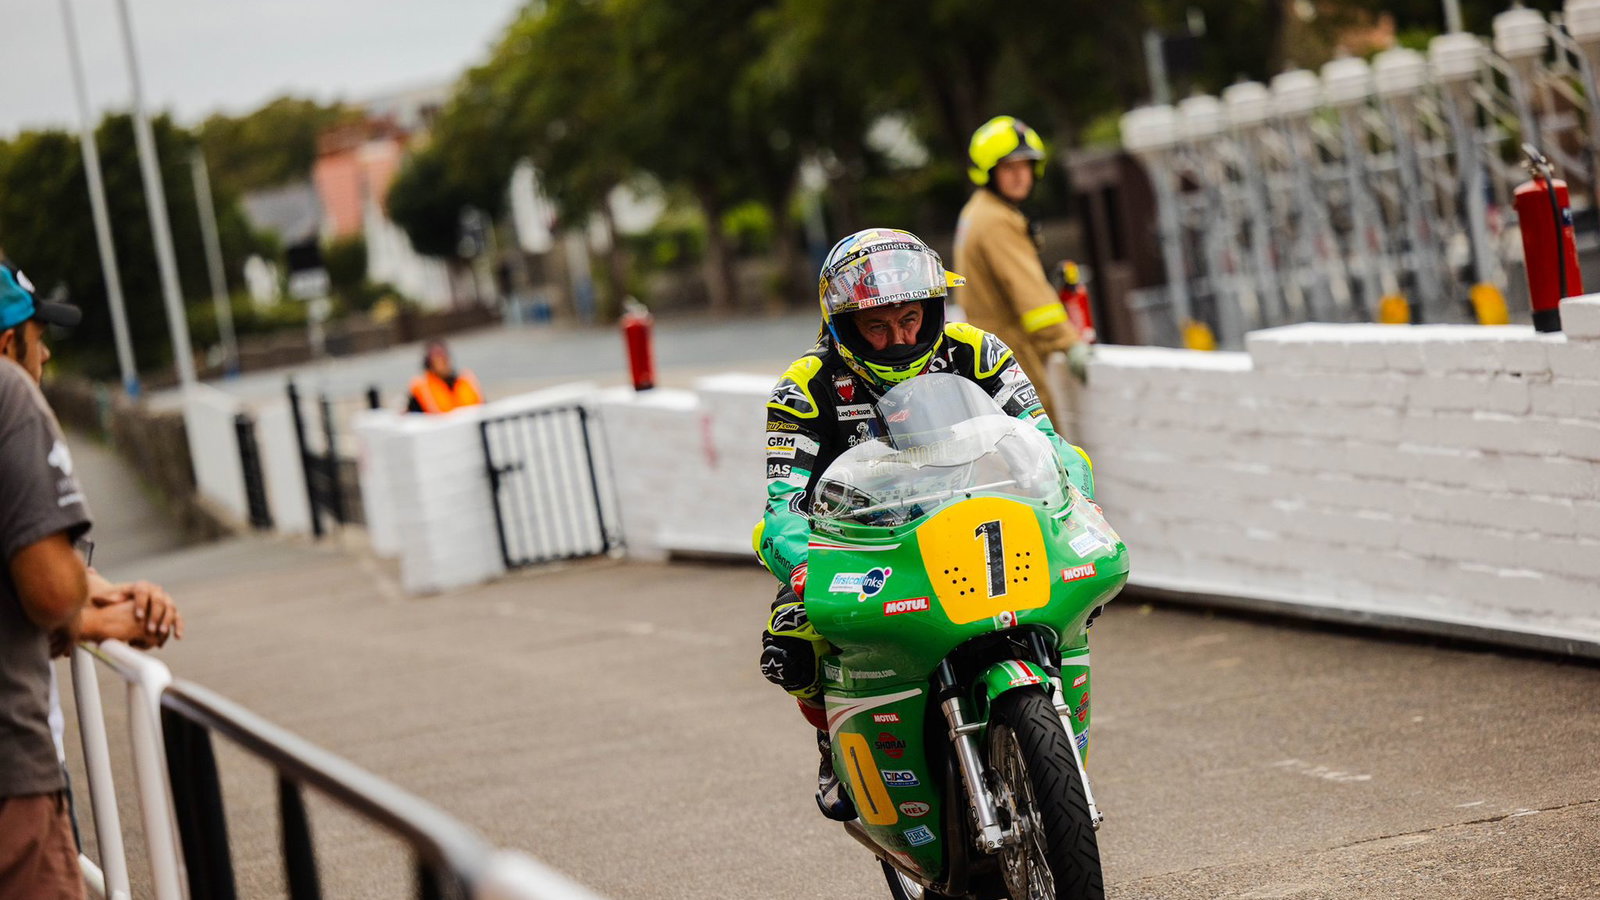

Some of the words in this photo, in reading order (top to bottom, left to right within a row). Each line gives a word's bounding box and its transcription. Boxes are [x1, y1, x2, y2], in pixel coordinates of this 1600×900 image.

[871, 241, 910, 253] Bennetts
[860, 290, 928, 308] REDTORPEDO.COM
[767, 437, 796, 447] GBM
[768, 464, 791, 476] BAS
[975, 519, 1007, 599] 1
[1063, 565, 1095, 581] MOTUL
[885, 599, 928, 613] MOTUL
[874, 714, 899, 723] MOTUL
[904, 806, 925, 815] HEL
